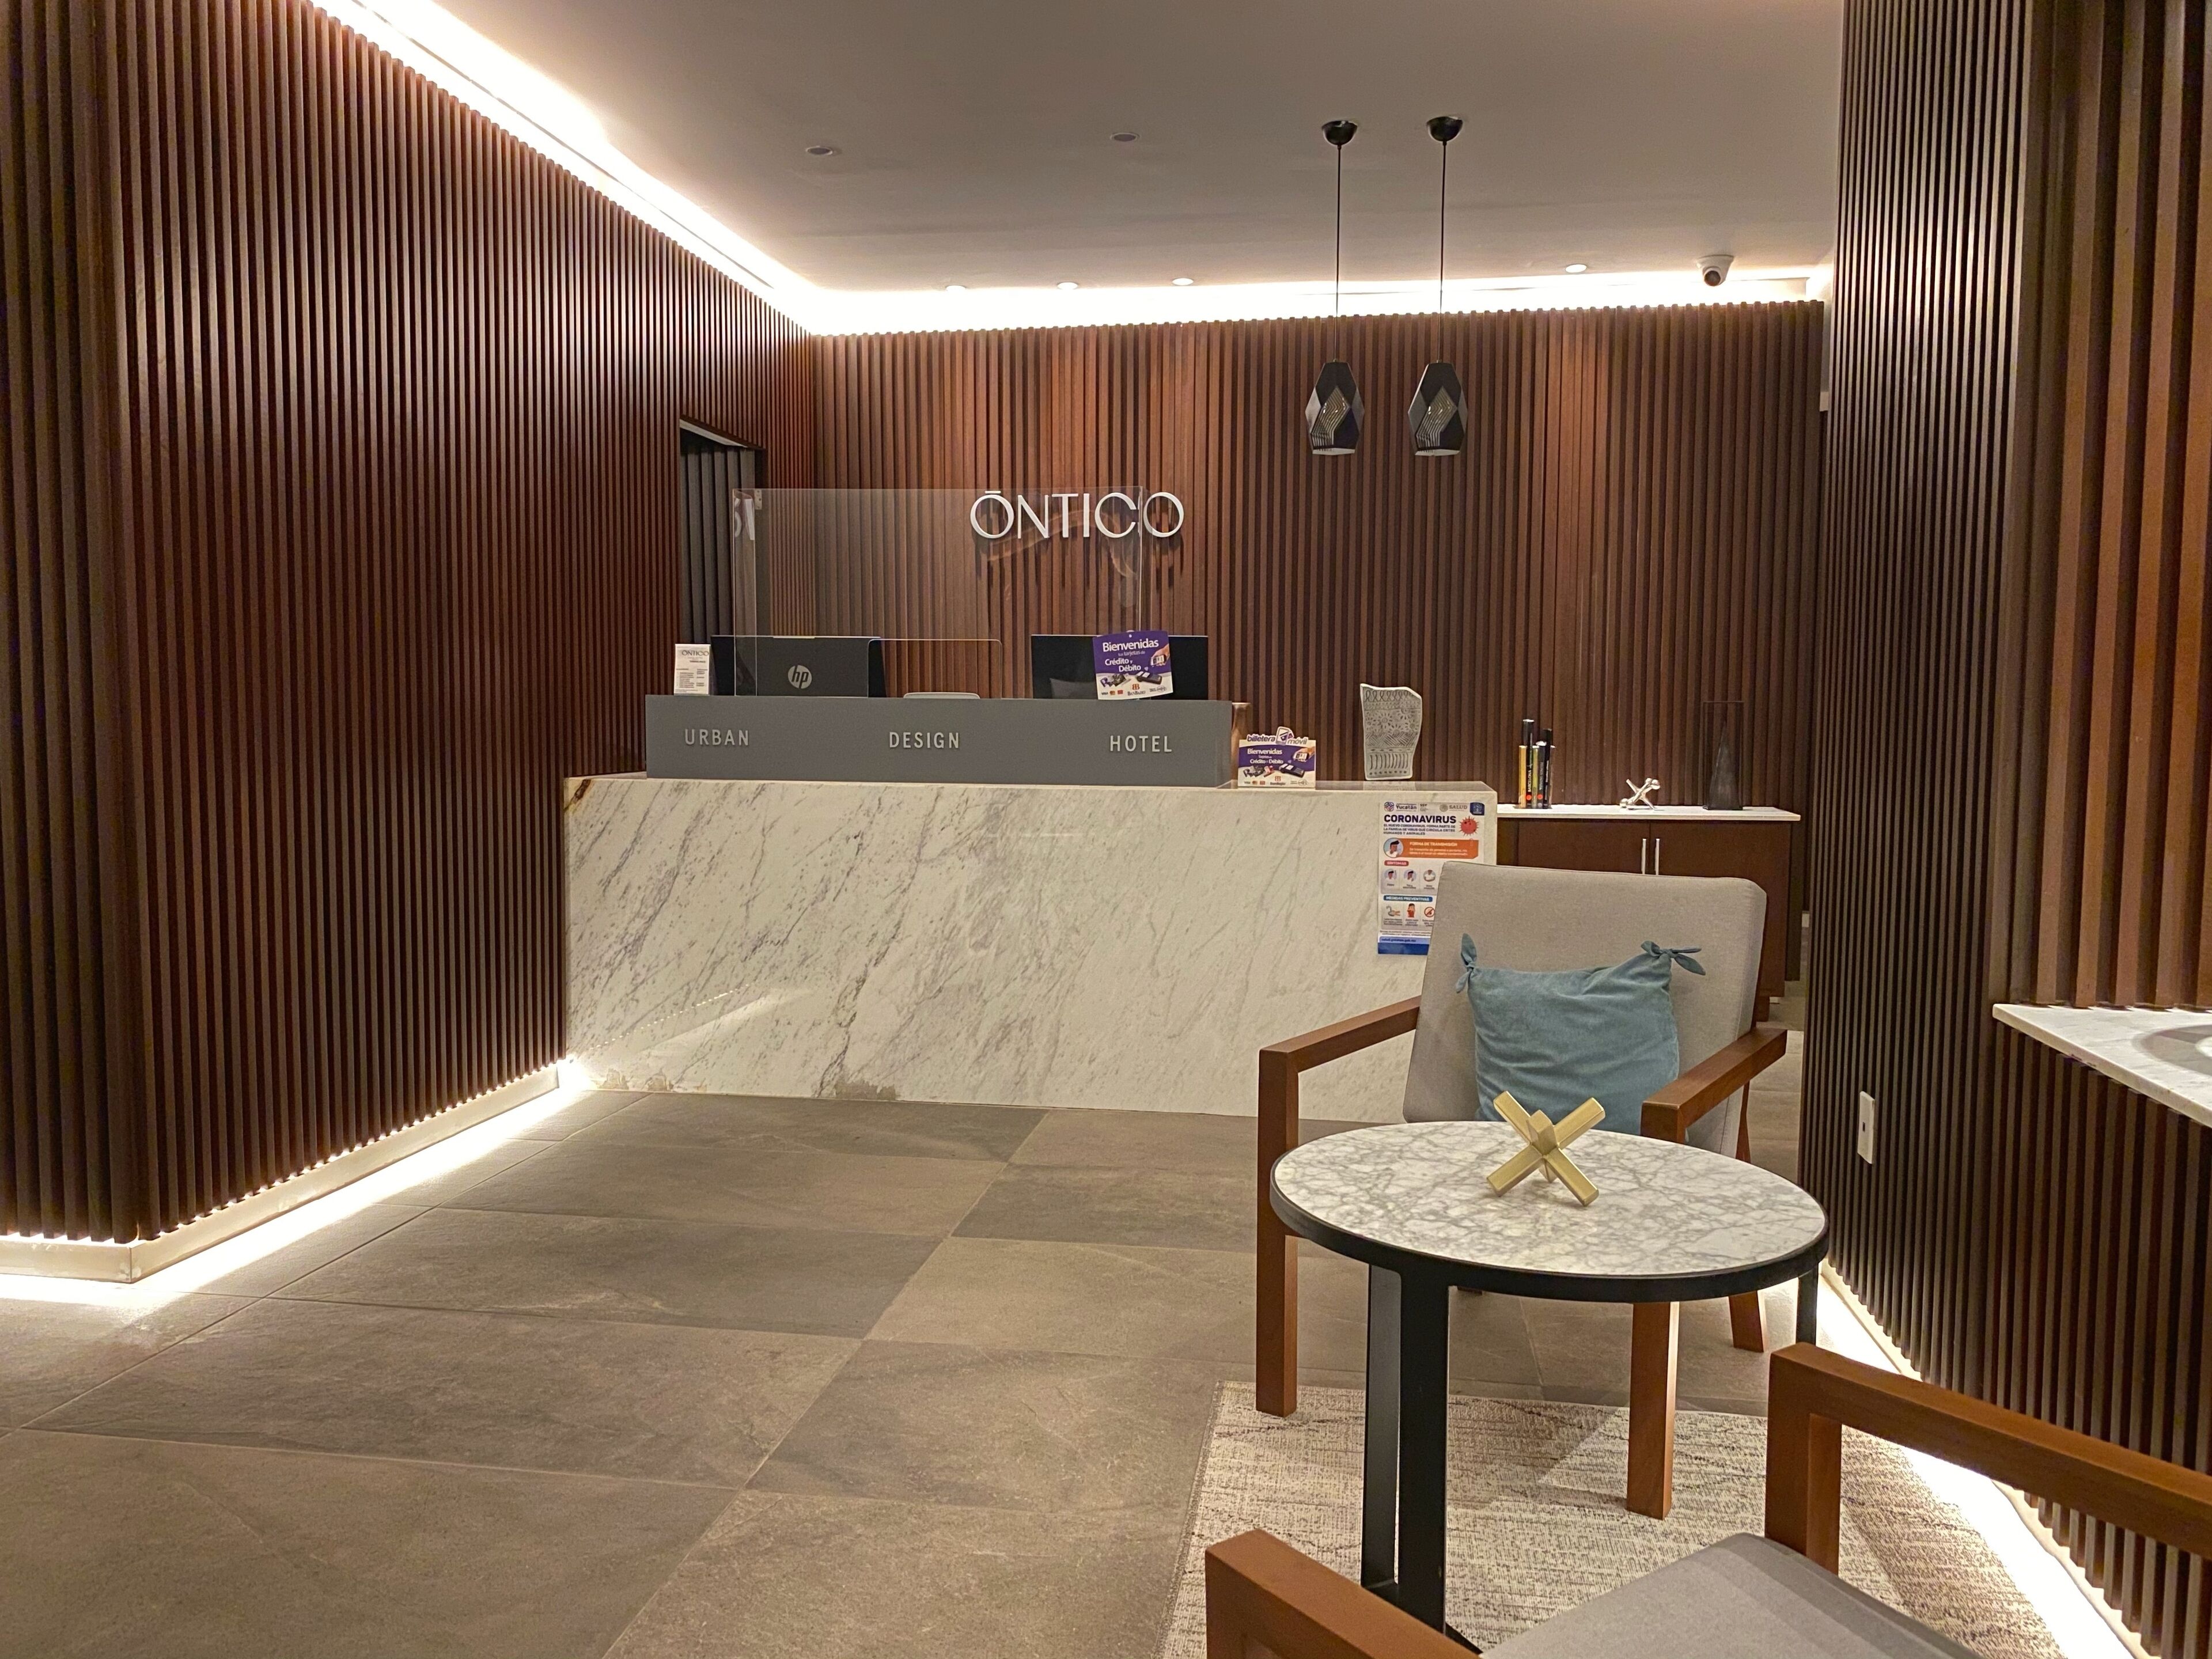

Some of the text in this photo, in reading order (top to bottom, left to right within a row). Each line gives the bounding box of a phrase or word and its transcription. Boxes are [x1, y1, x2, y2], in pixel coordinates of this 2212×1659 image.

[1102, 638, 1159, 652] Bienvenidas
[1105, 658, 1129, 666] Crédito
[788, 665, 812, 689] hp
[684, 729, 749, 745] URBAN
[889, 732, 960, 748] DESIGN
[1110, 735, 1172, 752] HOTEL
[1247, 734, 1276, 743] billetera
[1384, 815, 1456, 823] CORONAVIRUS
